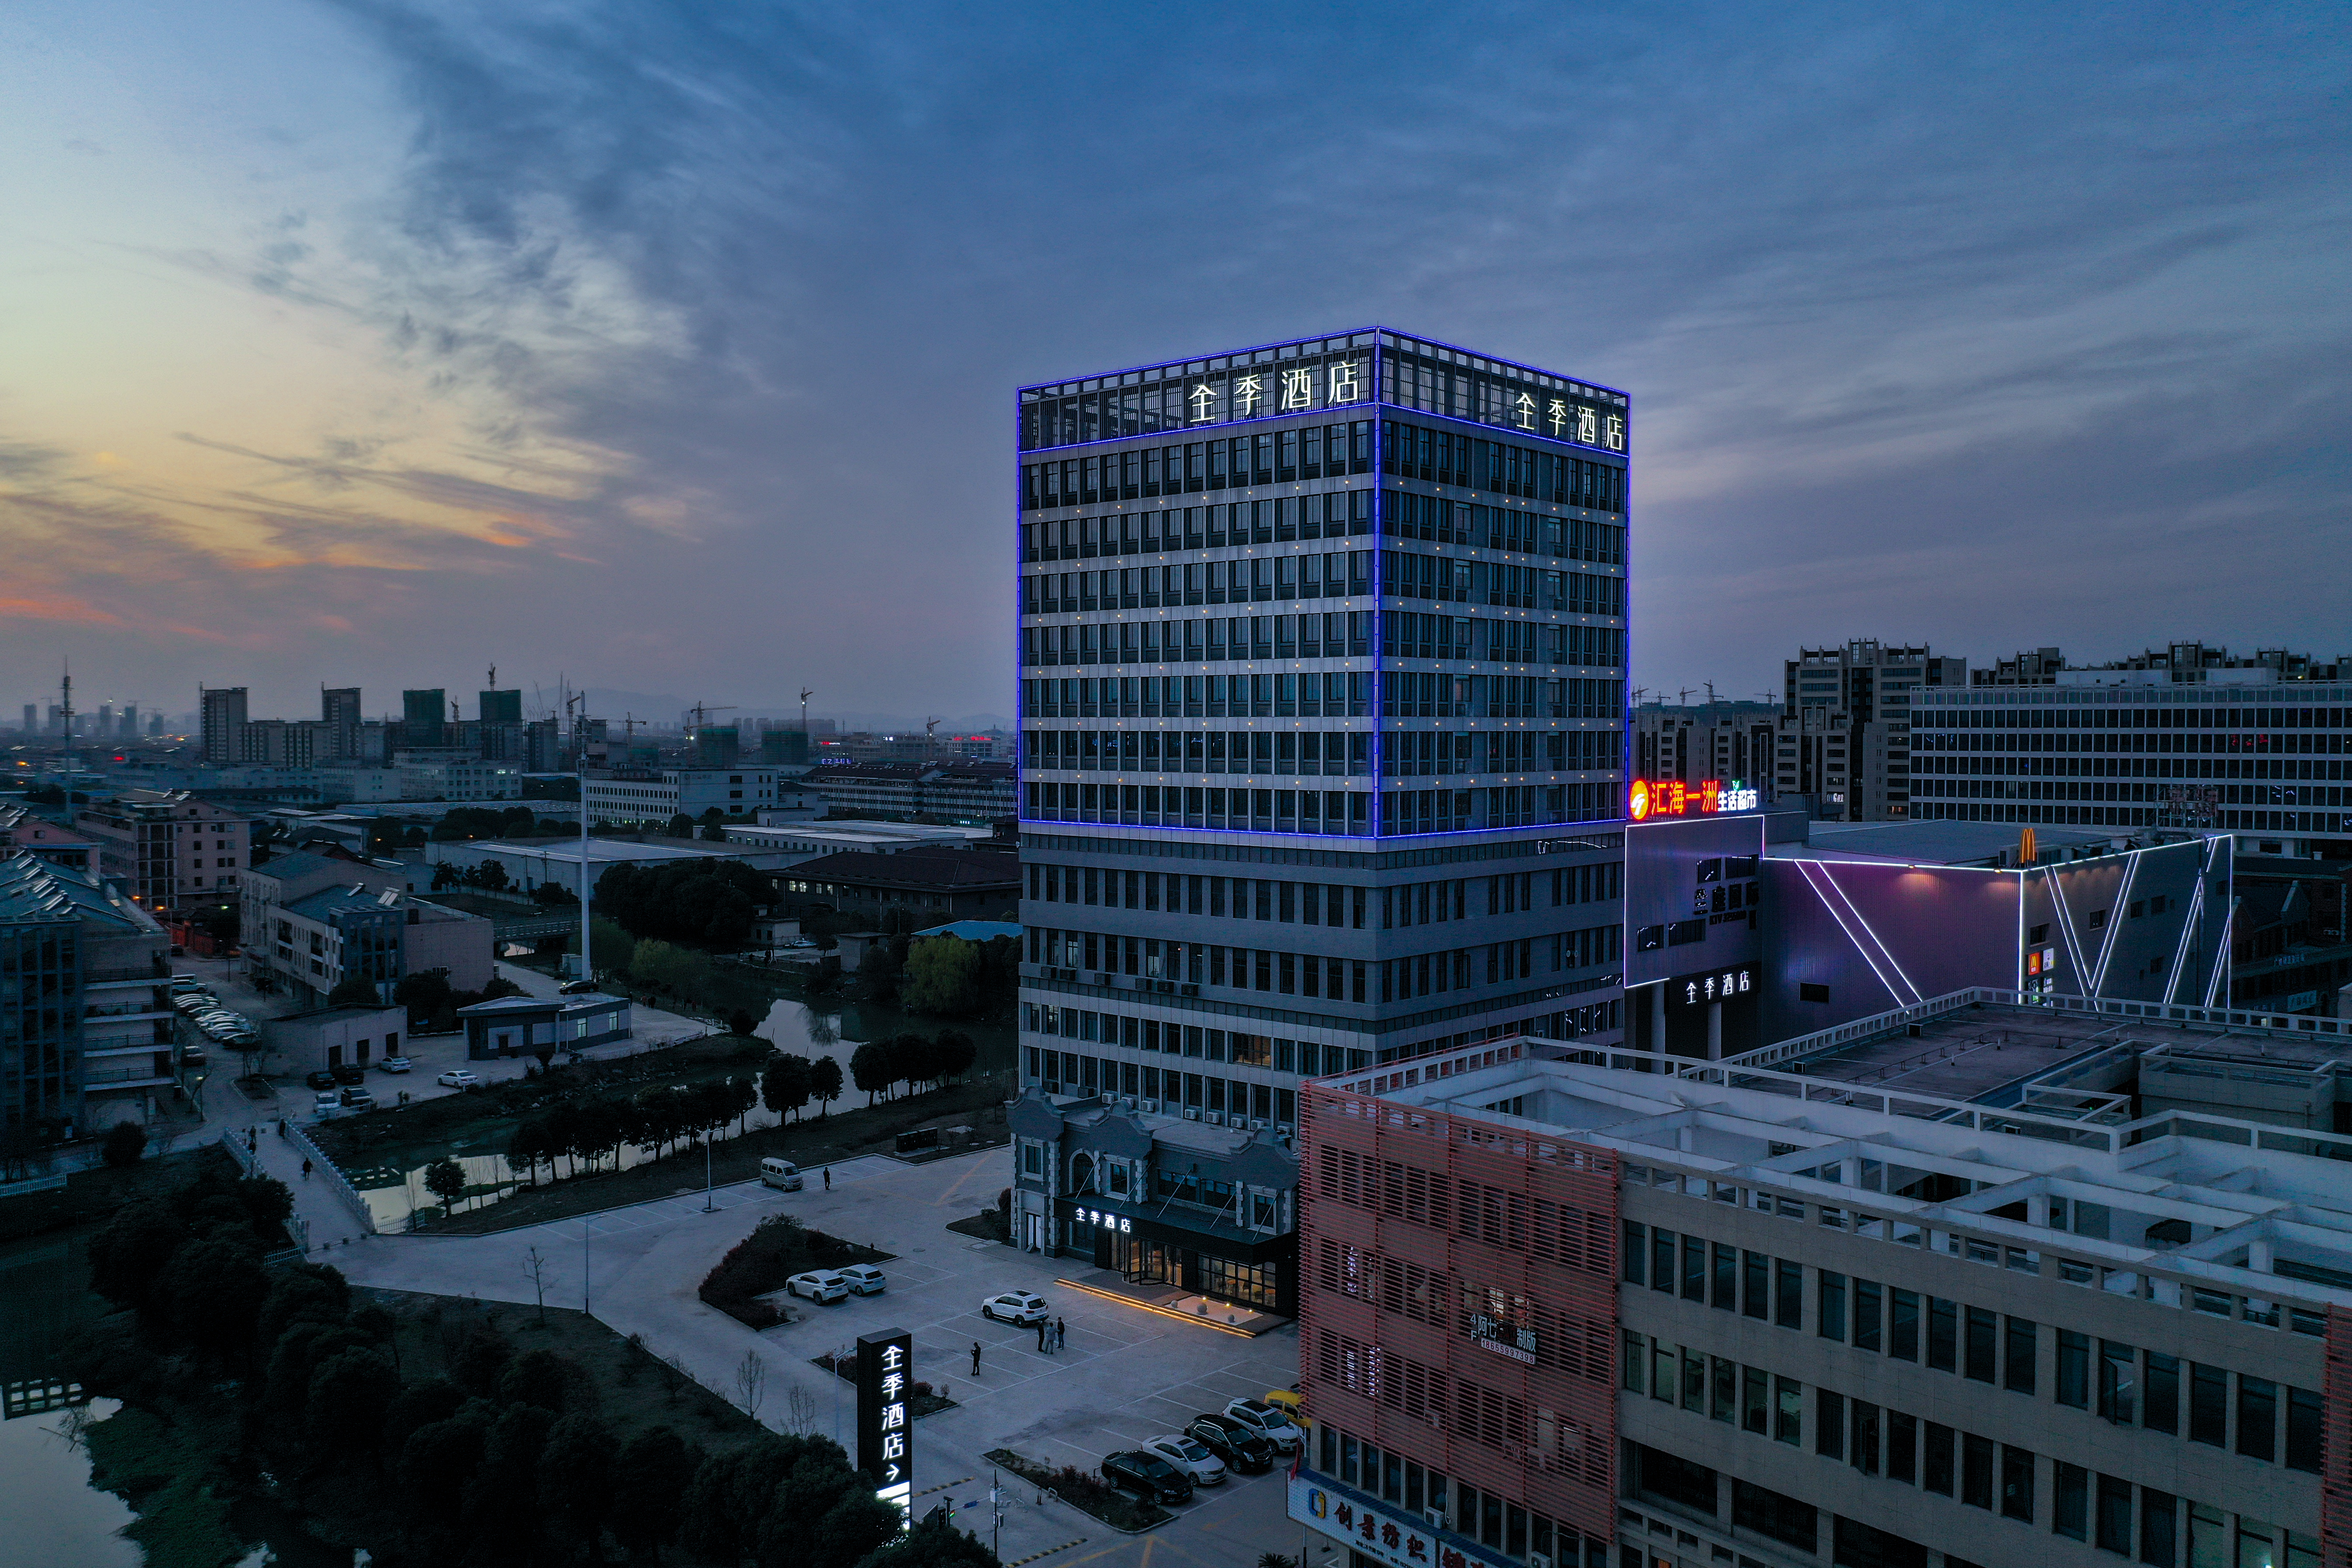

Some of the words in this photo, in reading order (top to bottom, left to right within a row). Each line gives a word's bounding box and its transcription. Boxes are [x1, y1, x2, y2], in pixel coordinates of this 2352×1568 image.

[1188, 361, 1358, 422] 全季酒店
[1515, 393, 1622, 450] 全季酒店
[1651, 781, 1717, 815] 汇海一洲
[1717, 789, 1756, 811] 生活超市
[1686, 970, 1748, 1004] 全季酒店
[1076, 1207, 1130, 1233] 全季酒店
[1482, 1340, 1534, 1363] 18655997398
[881, 1345, 903, 1460] 全季酒店
